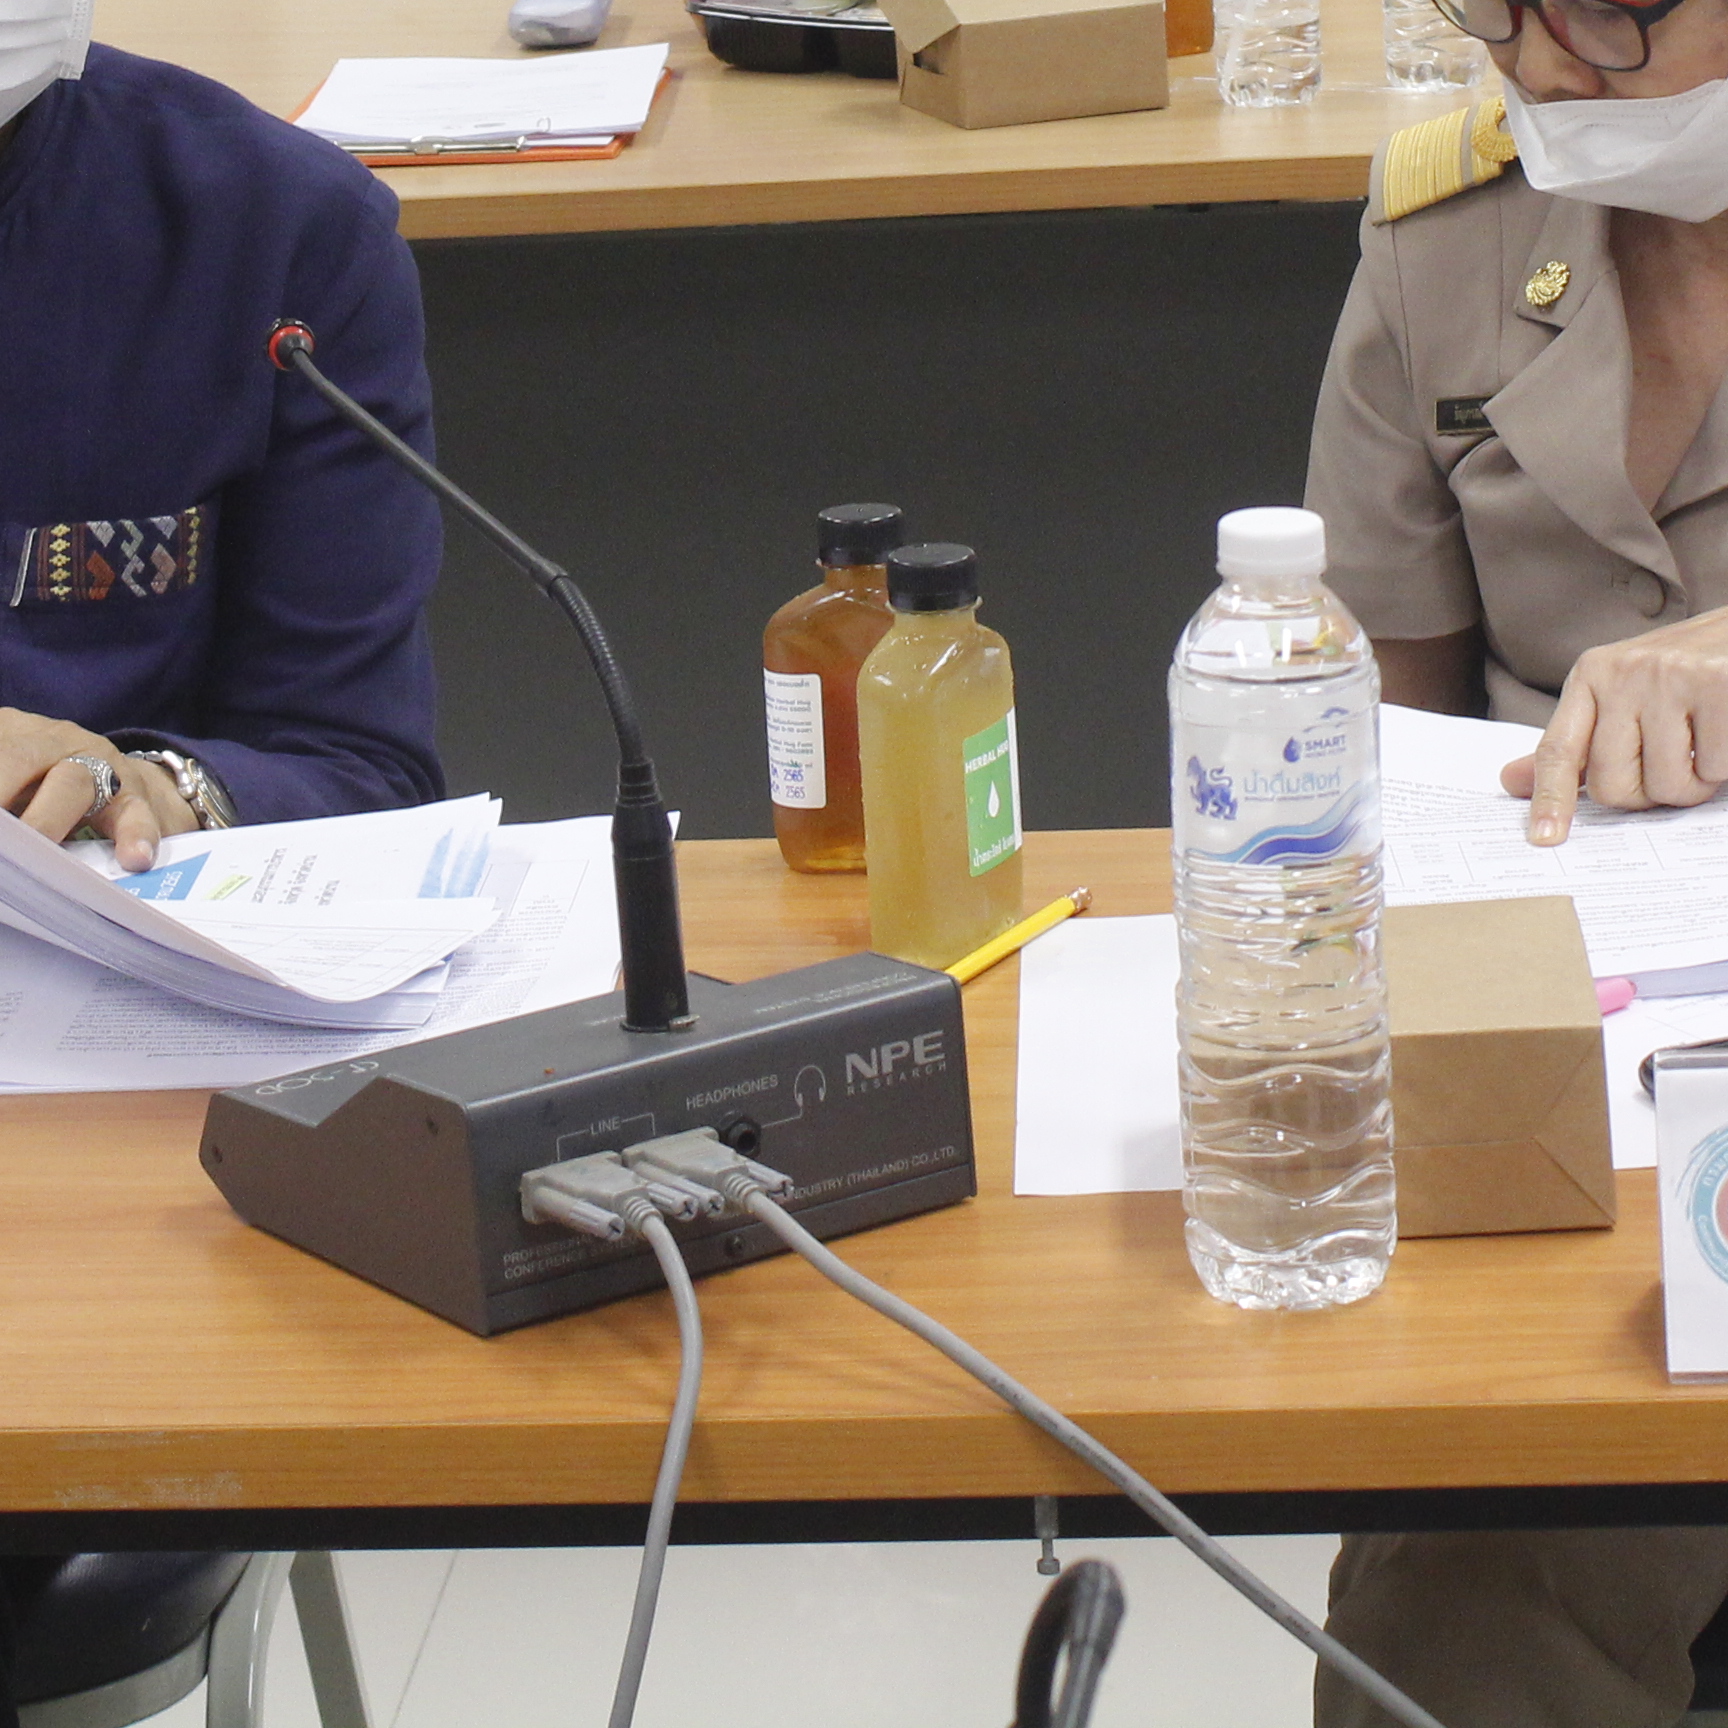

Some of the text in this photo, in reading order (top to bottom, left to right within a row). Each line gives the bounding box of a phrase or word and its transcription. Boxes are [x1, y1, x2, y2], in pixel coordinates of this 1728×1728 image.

[1305, 734, 1346, 752] SMART
[965, 748, 997, 774] HERBAL
[845, 1030, 946, 1085] NPE
[686, 1074, 779, 1111] HEADPHONES
[847, 1061, 948, 1096] RESEARCH
[589, 1116, 622, 1136] LINE
[790, 1176, 845, 1200] NDUSTRY
[846, 1159, 909, 1188] (THAILAND)
